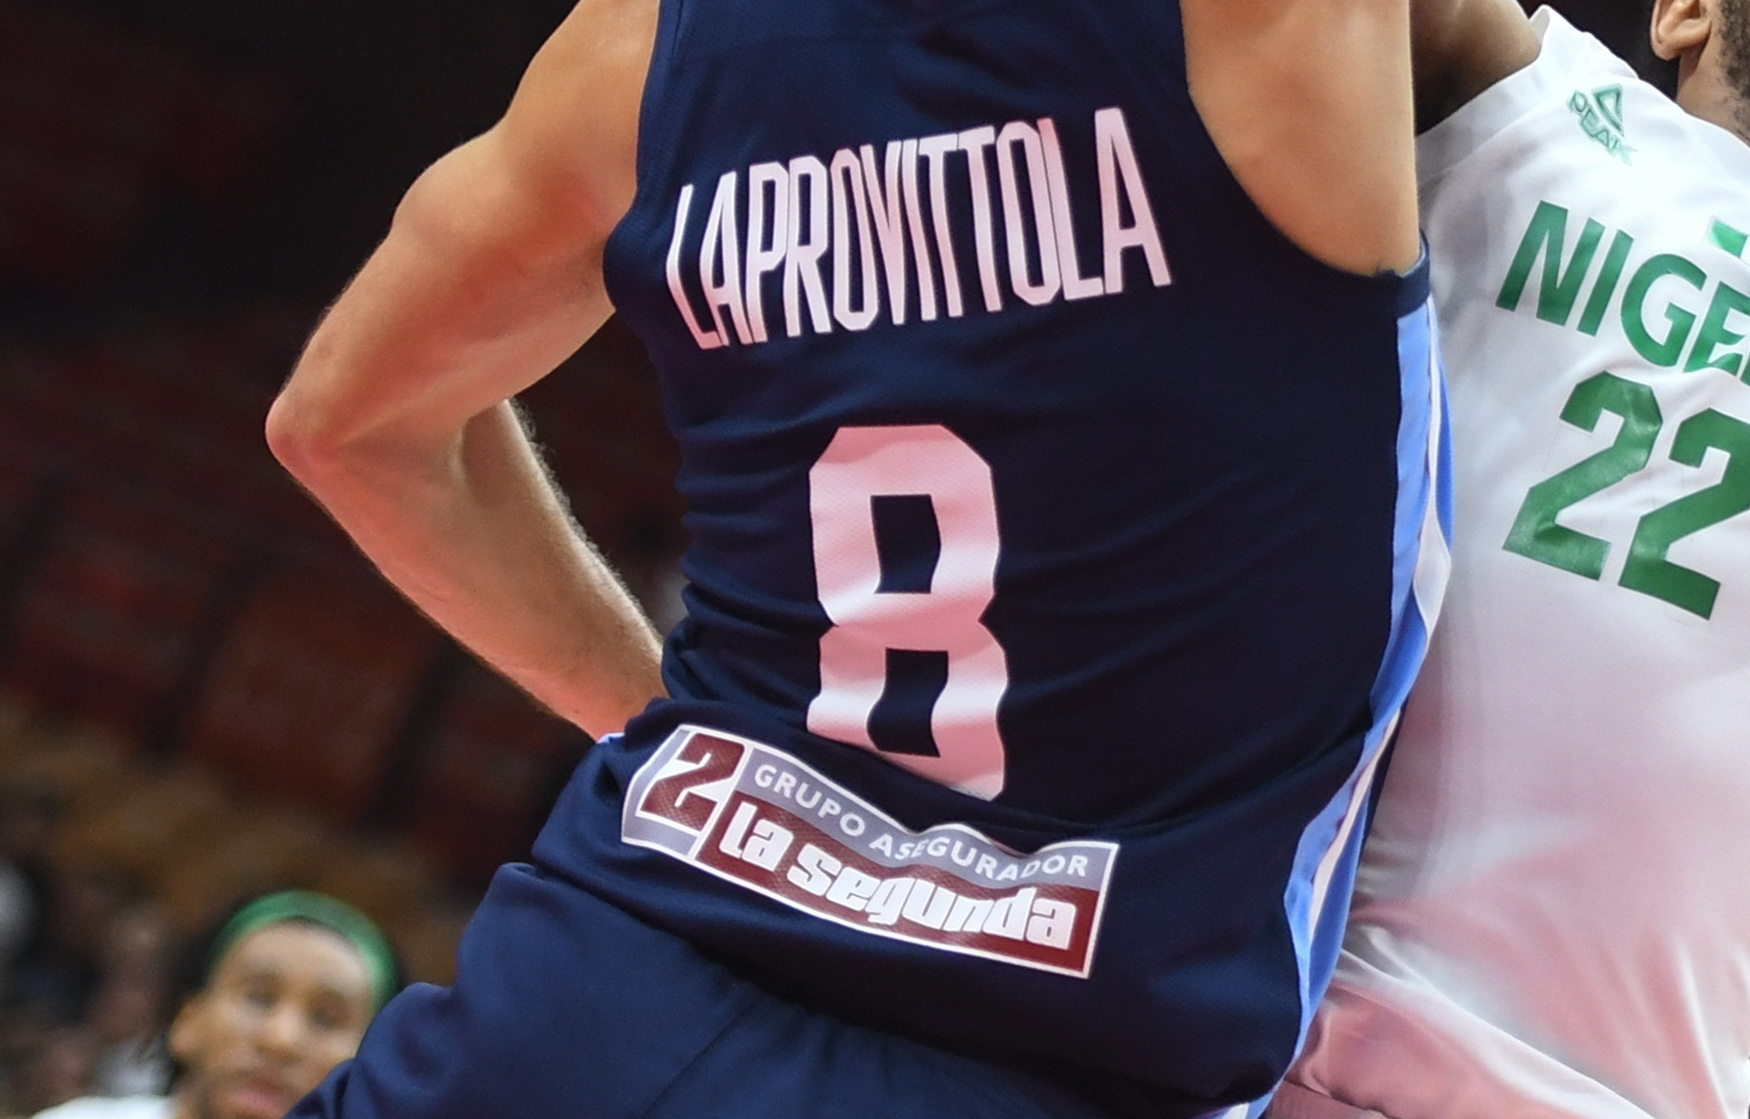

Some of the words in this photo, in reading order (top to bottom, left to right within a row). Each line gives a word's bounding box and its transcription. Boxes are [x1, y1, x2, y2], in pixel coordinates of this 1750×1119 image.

[1566, 89, 1638, 168] PEAK
[665, 107, 1172, 350] LAPROVITTOLA
[806, 423, 1009, 802] 8
[639, 732, 746, 833] 2
[754, 763, 867, 838] GRUPO
[868, 832, 1089, 881] ASEGURADOR
